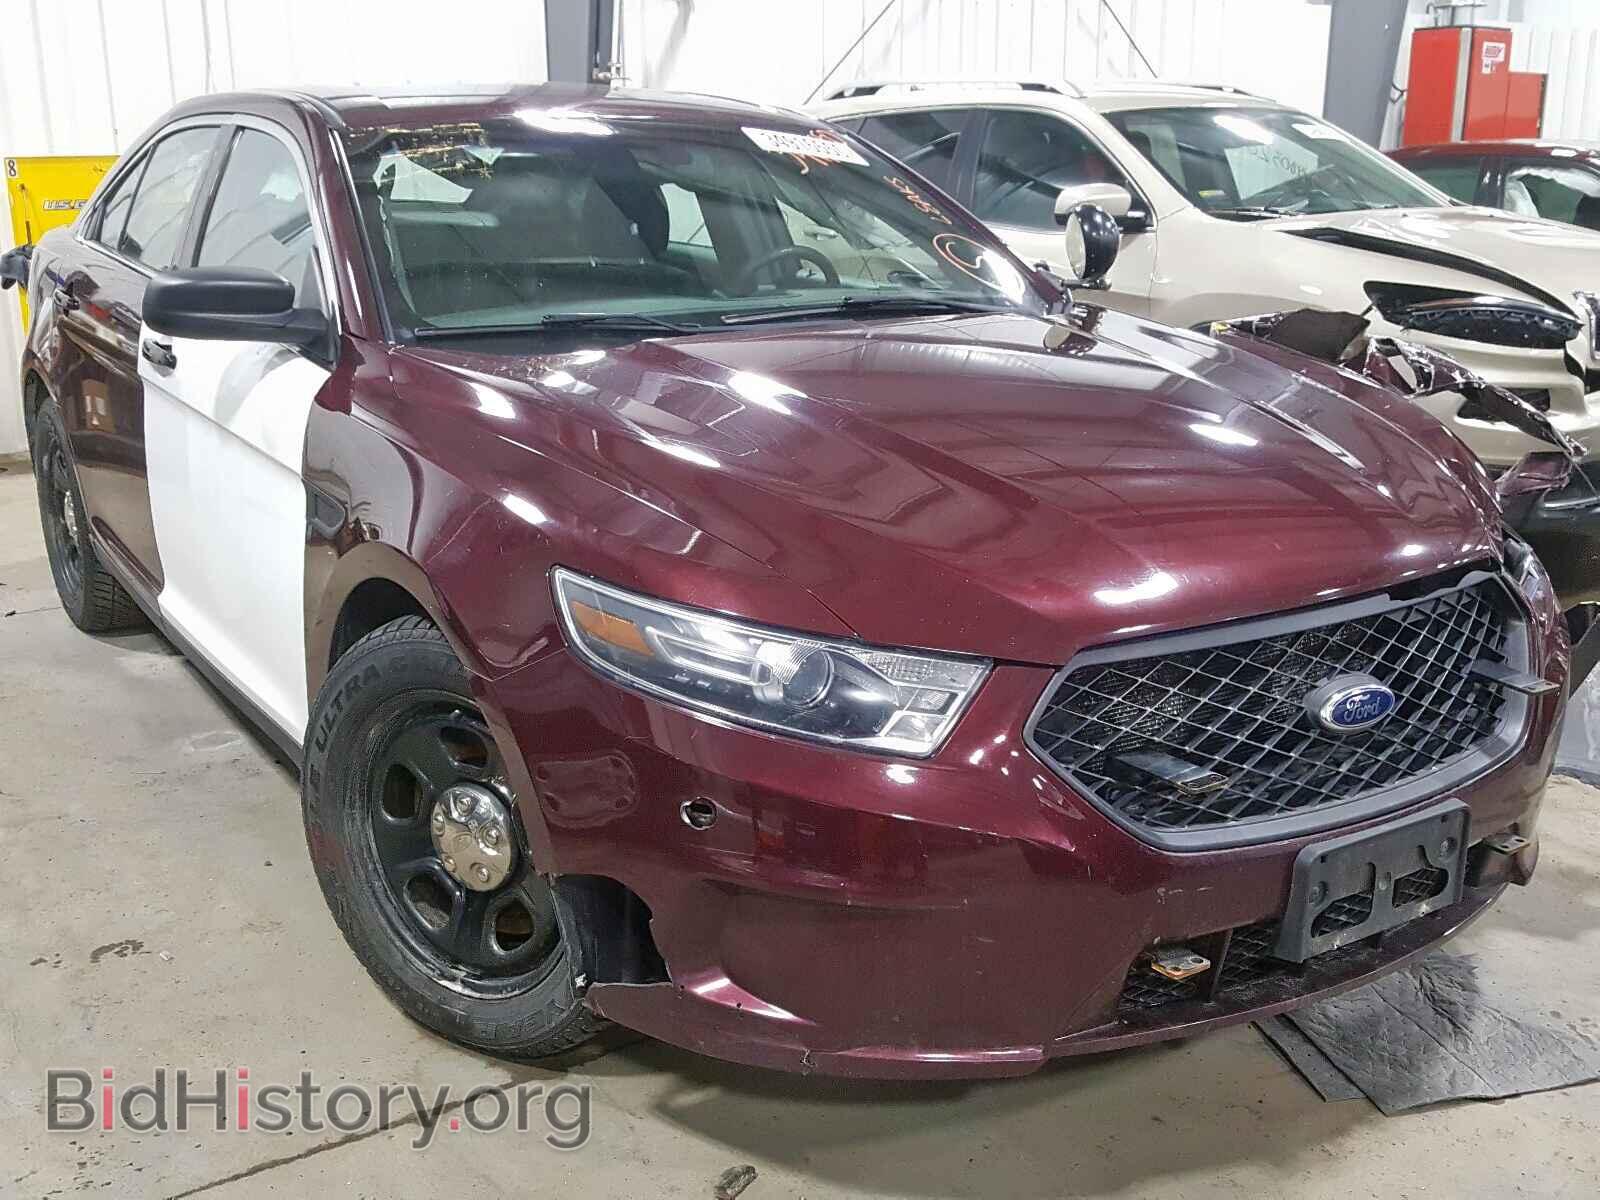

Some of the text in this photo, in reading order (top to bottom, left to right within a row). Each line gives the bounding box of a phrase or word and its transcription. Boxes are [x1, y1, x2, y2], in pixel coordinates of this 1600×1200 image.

[8, 160, 17, 177] 8
[315, 663, 382, 752] ULTRA
[1343, 693, 1381, 722] Ford
